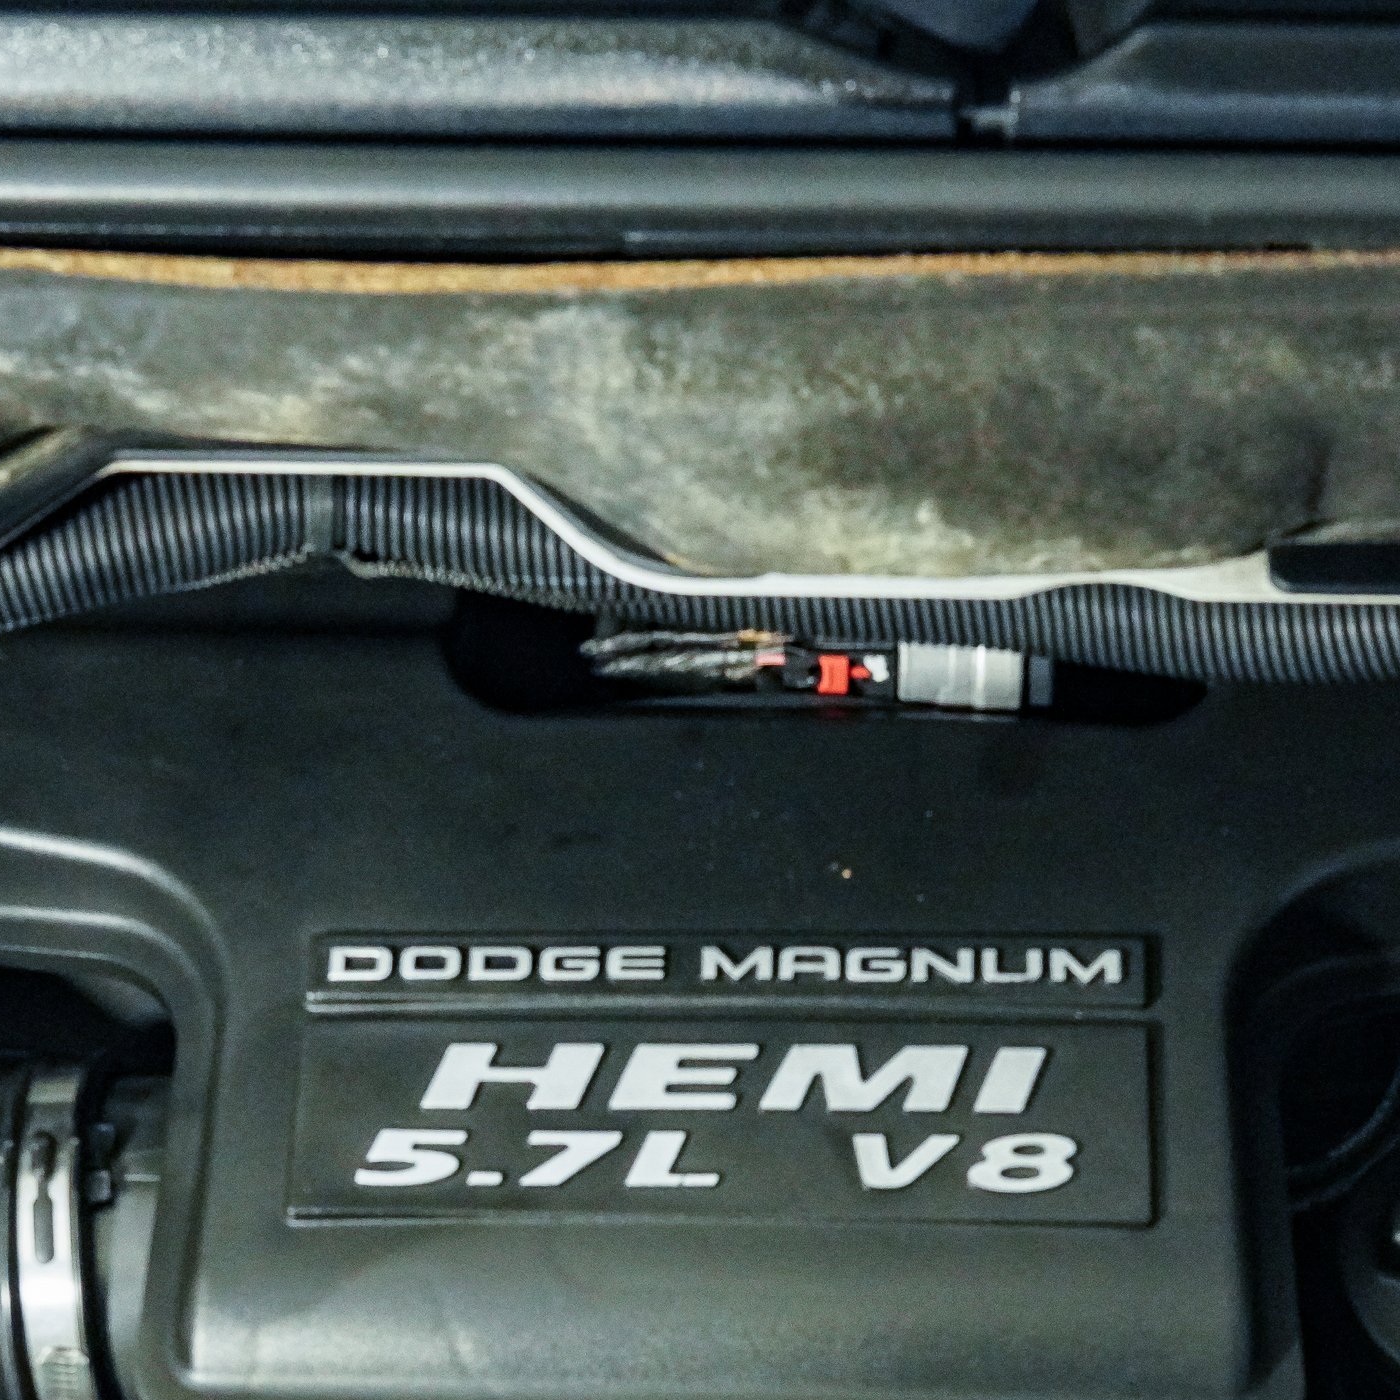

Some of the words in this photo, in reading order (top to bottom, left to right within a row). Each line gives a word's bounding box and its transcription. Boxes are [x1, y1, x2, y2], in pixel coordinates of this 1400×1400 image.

[326, 945, 666, 983] DODGE
[700, 946, 1123, 985] MAGNUM
[418, 1042, 1047, 1115] HEMI
[353, 1128, 721, 1188] 5.7L
[851, 1132, 1078, 1193] V8
